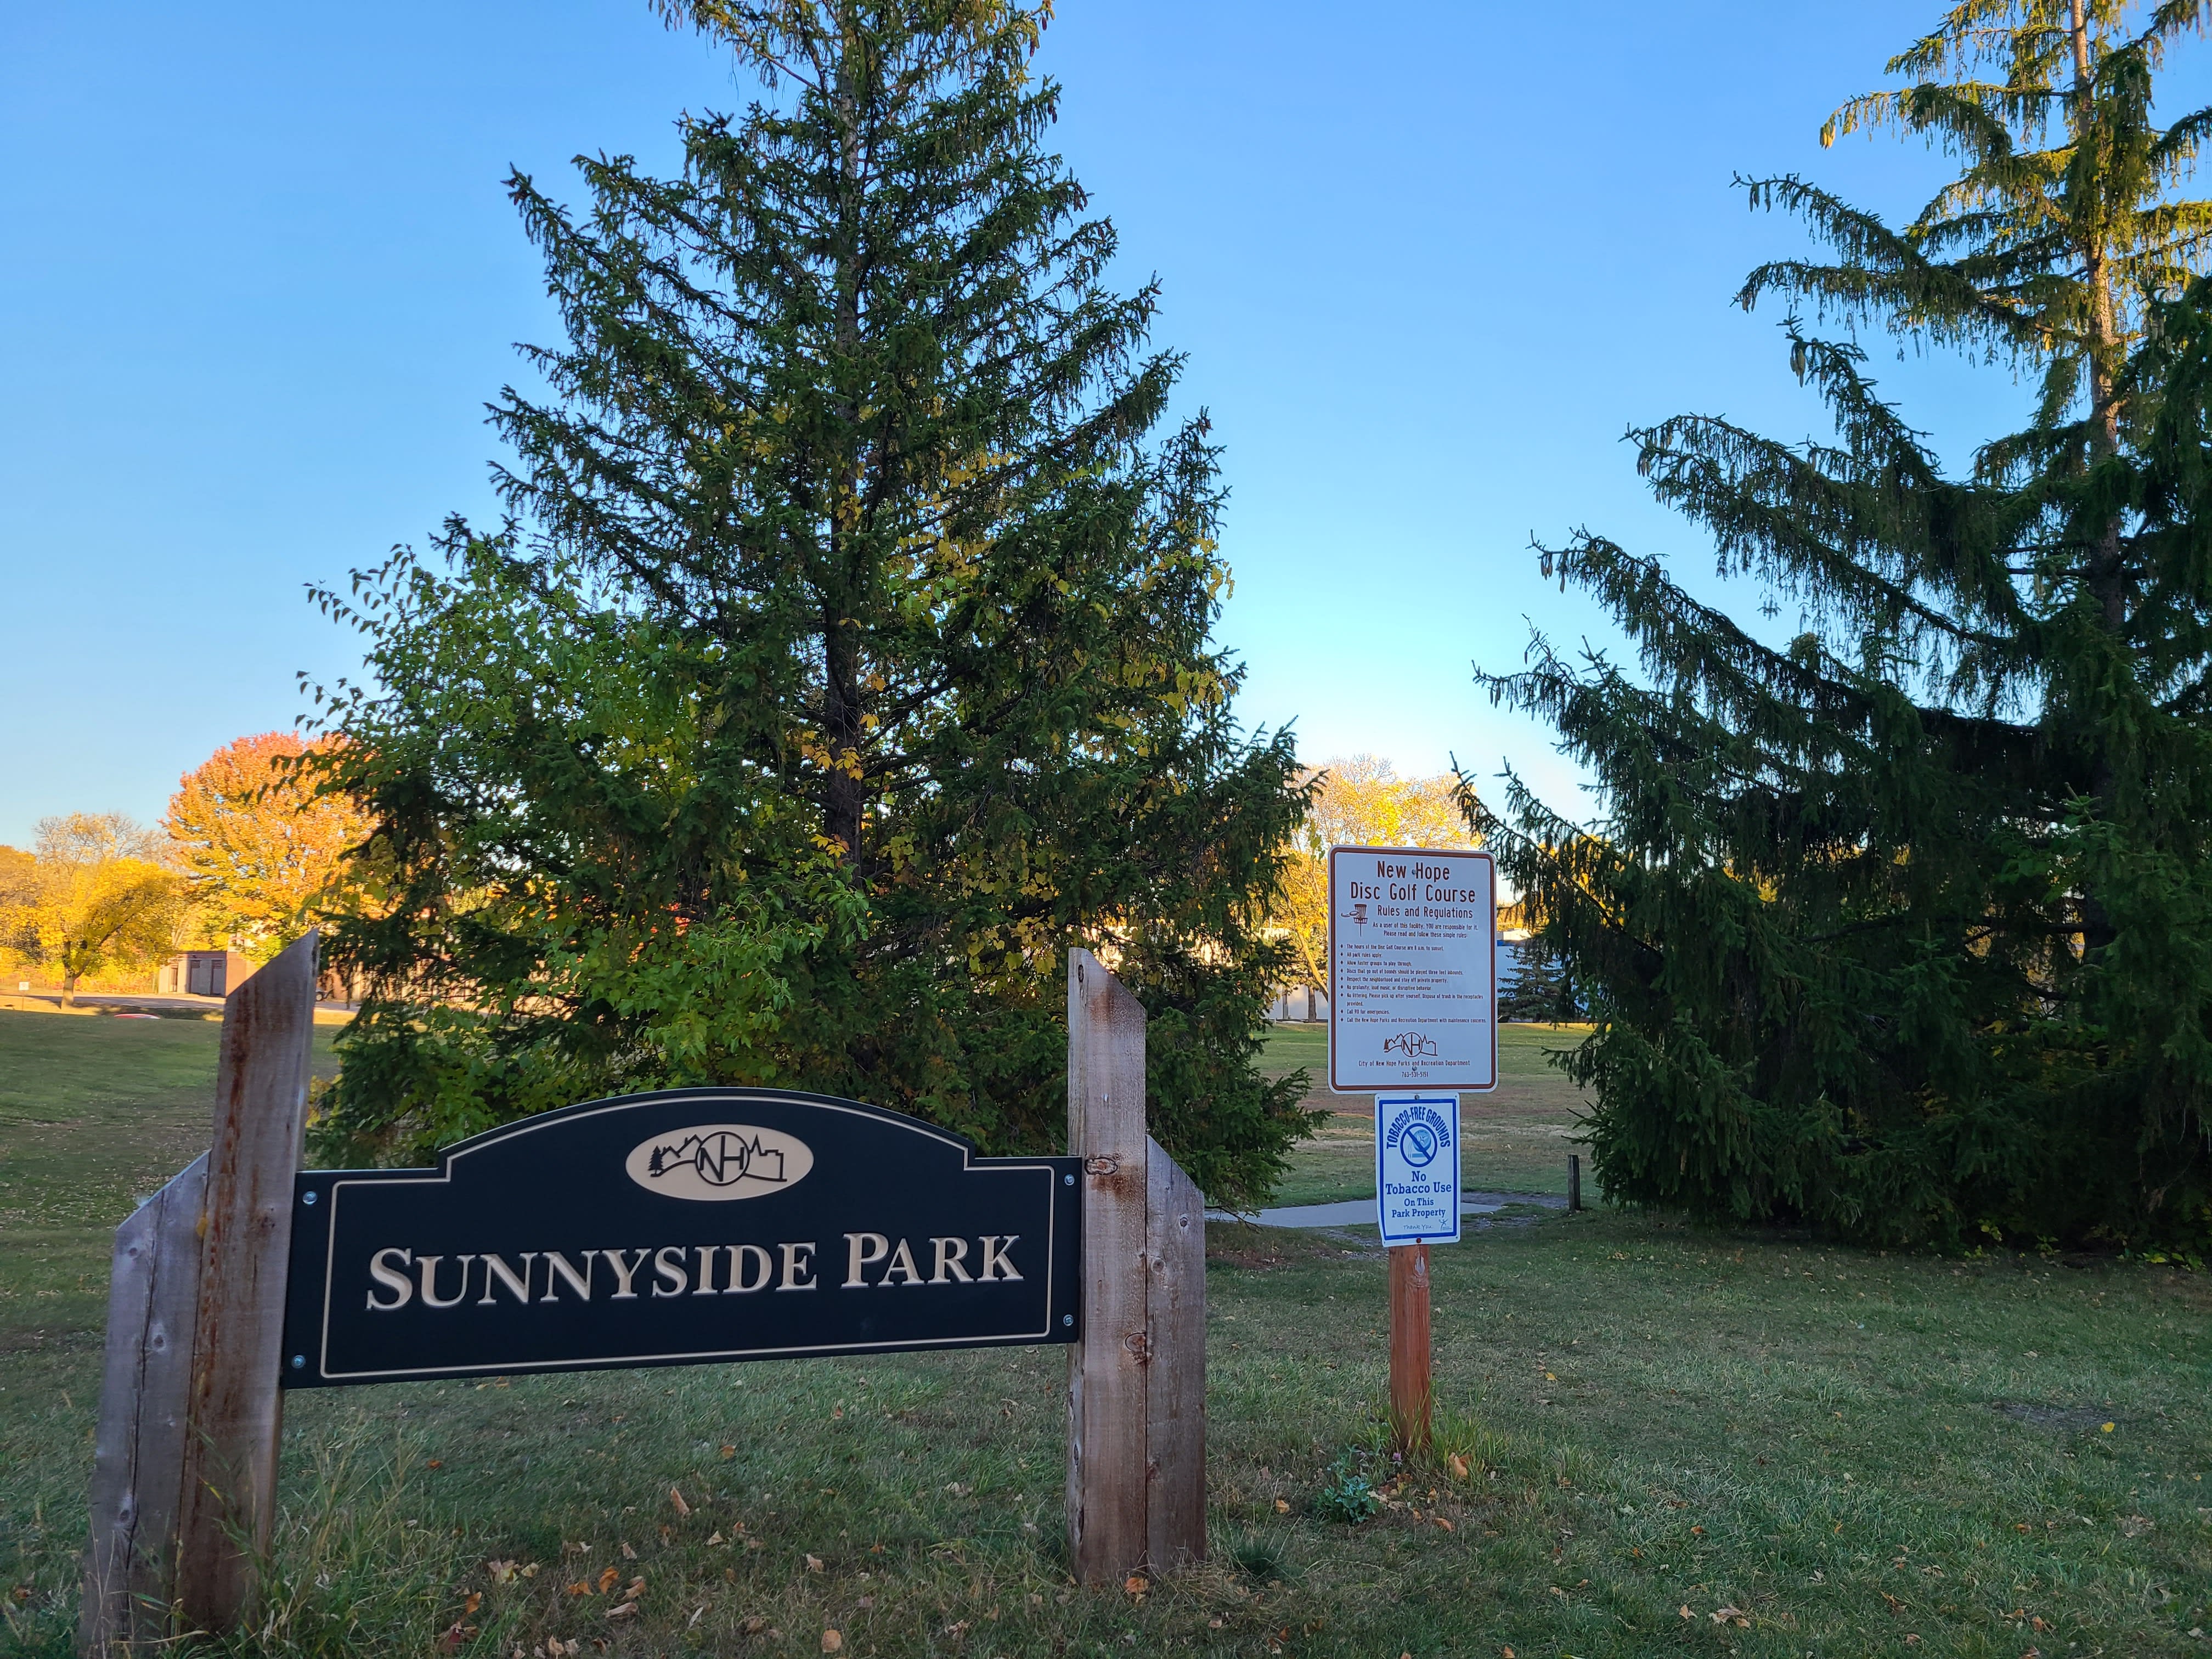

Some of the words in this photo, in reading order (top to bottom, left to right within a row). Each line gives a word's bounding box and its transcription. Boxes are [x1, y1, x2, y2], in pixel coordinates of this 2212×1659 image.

[1378, 861, 1406, 878] New
[1416, 862, 1450, 882] Hope
[1351, 881, 1381, 900] Disc
[1390, 883, 1417, 901] Golf
[1426, 884, 1476, 903] Course
[1378, 905, 1400, 916] Rules
[1404, 906, 1419, 917] and
[1424, 906, 1473, 920] Regulations
[1403, 1034, 1421, 1056] NH
[1386, 1106, 1426, 1149] TOBACCO-FREE
[1426, 1109, 1451, 1148] GROUNDS
[699, 1135, 745, 1182] NH
[1411, 1171, 1426, 1182] No
[1385, 1183, 1430, 1195] Tobacco
[1433, 1182, 1452, 1193] Use
[1404, 1198, 1415, 1206] On
[1417, 1197, 1434, 1206] This
[1392, 1209, 1410, 1218] Park
[1412, 1208, 1446, 1218] Property
